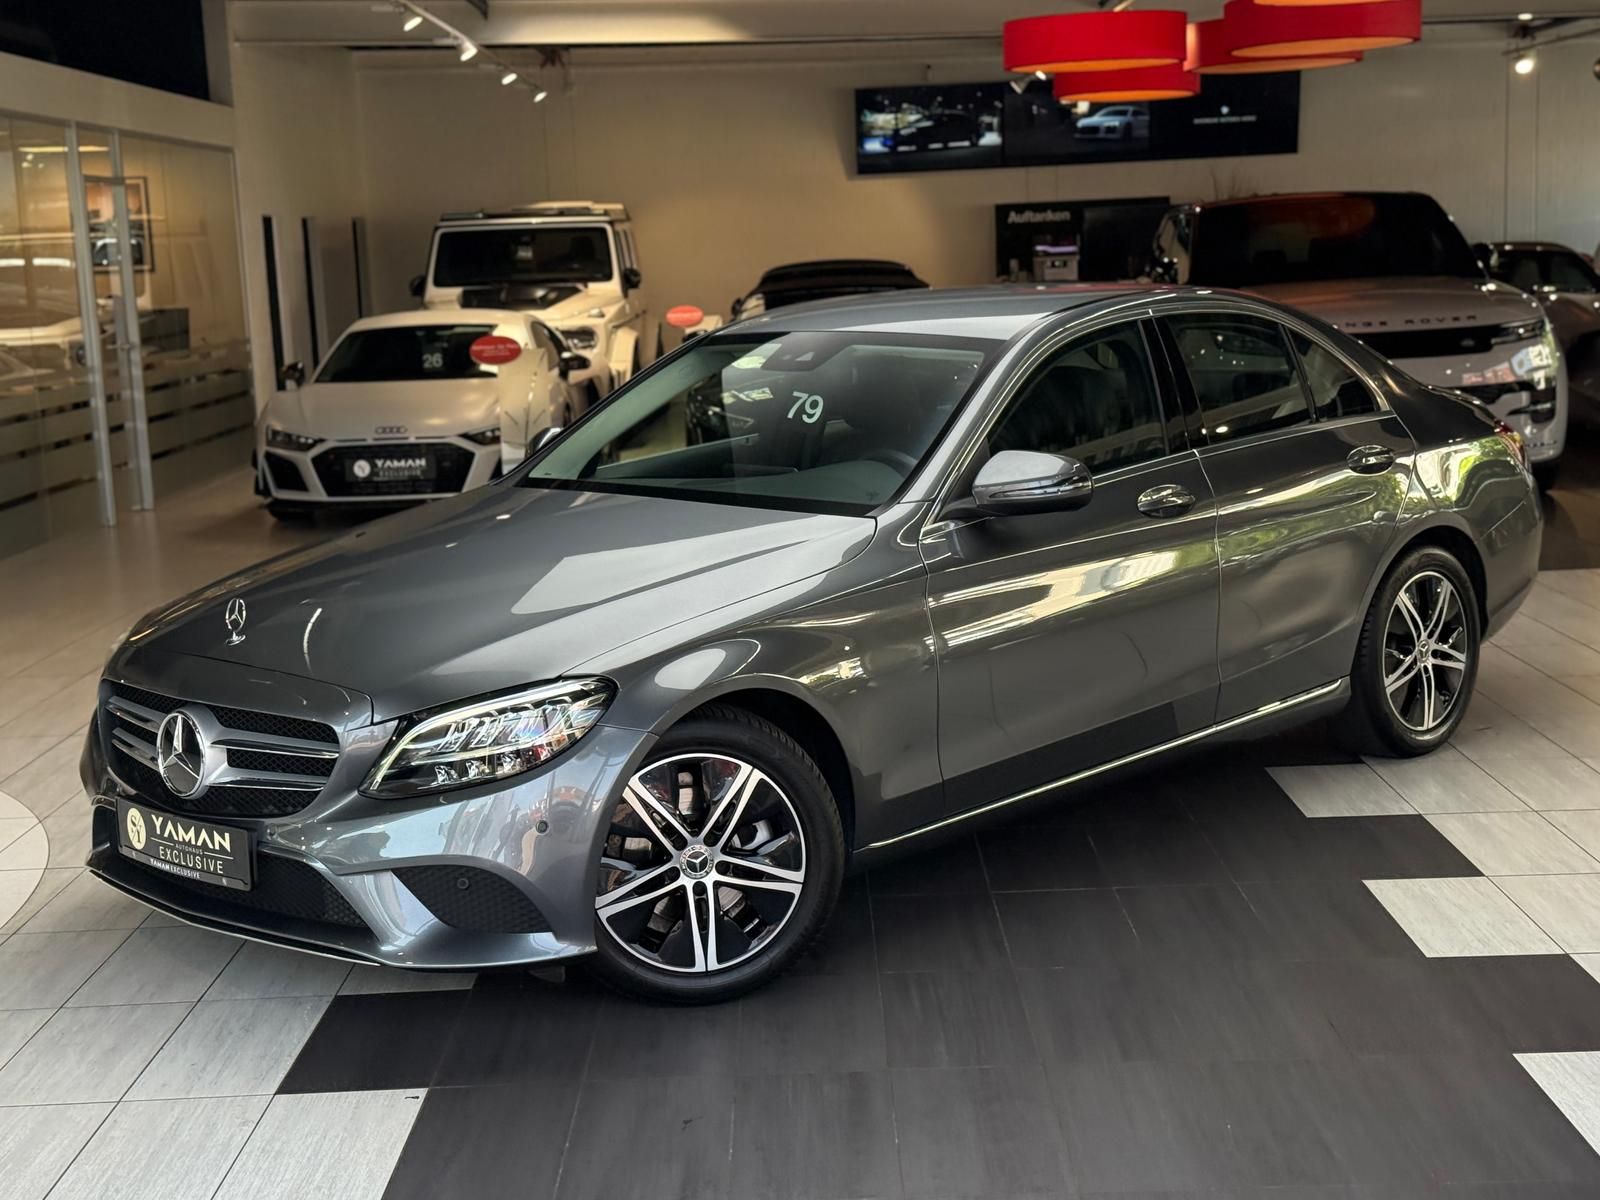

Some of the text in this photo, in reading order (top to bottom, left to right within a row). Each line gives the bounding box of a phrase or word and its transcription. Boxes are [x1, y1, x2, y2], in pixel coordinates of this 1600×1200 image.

[1404, 315, 1477, 325] ROVER
[422, 353, 443, 368] 26
[786, 391, 824, 424] 79
[374, 458, 426, 468] YAMAN
[151, 814, 231, 853] YAMAN
[175, 843, 204, 855] AUTOHAUS
[149, 858, 201, 879] YAMAN EXCLUSIVE
[159, 846, 224, 874] EXCLUSIVE
